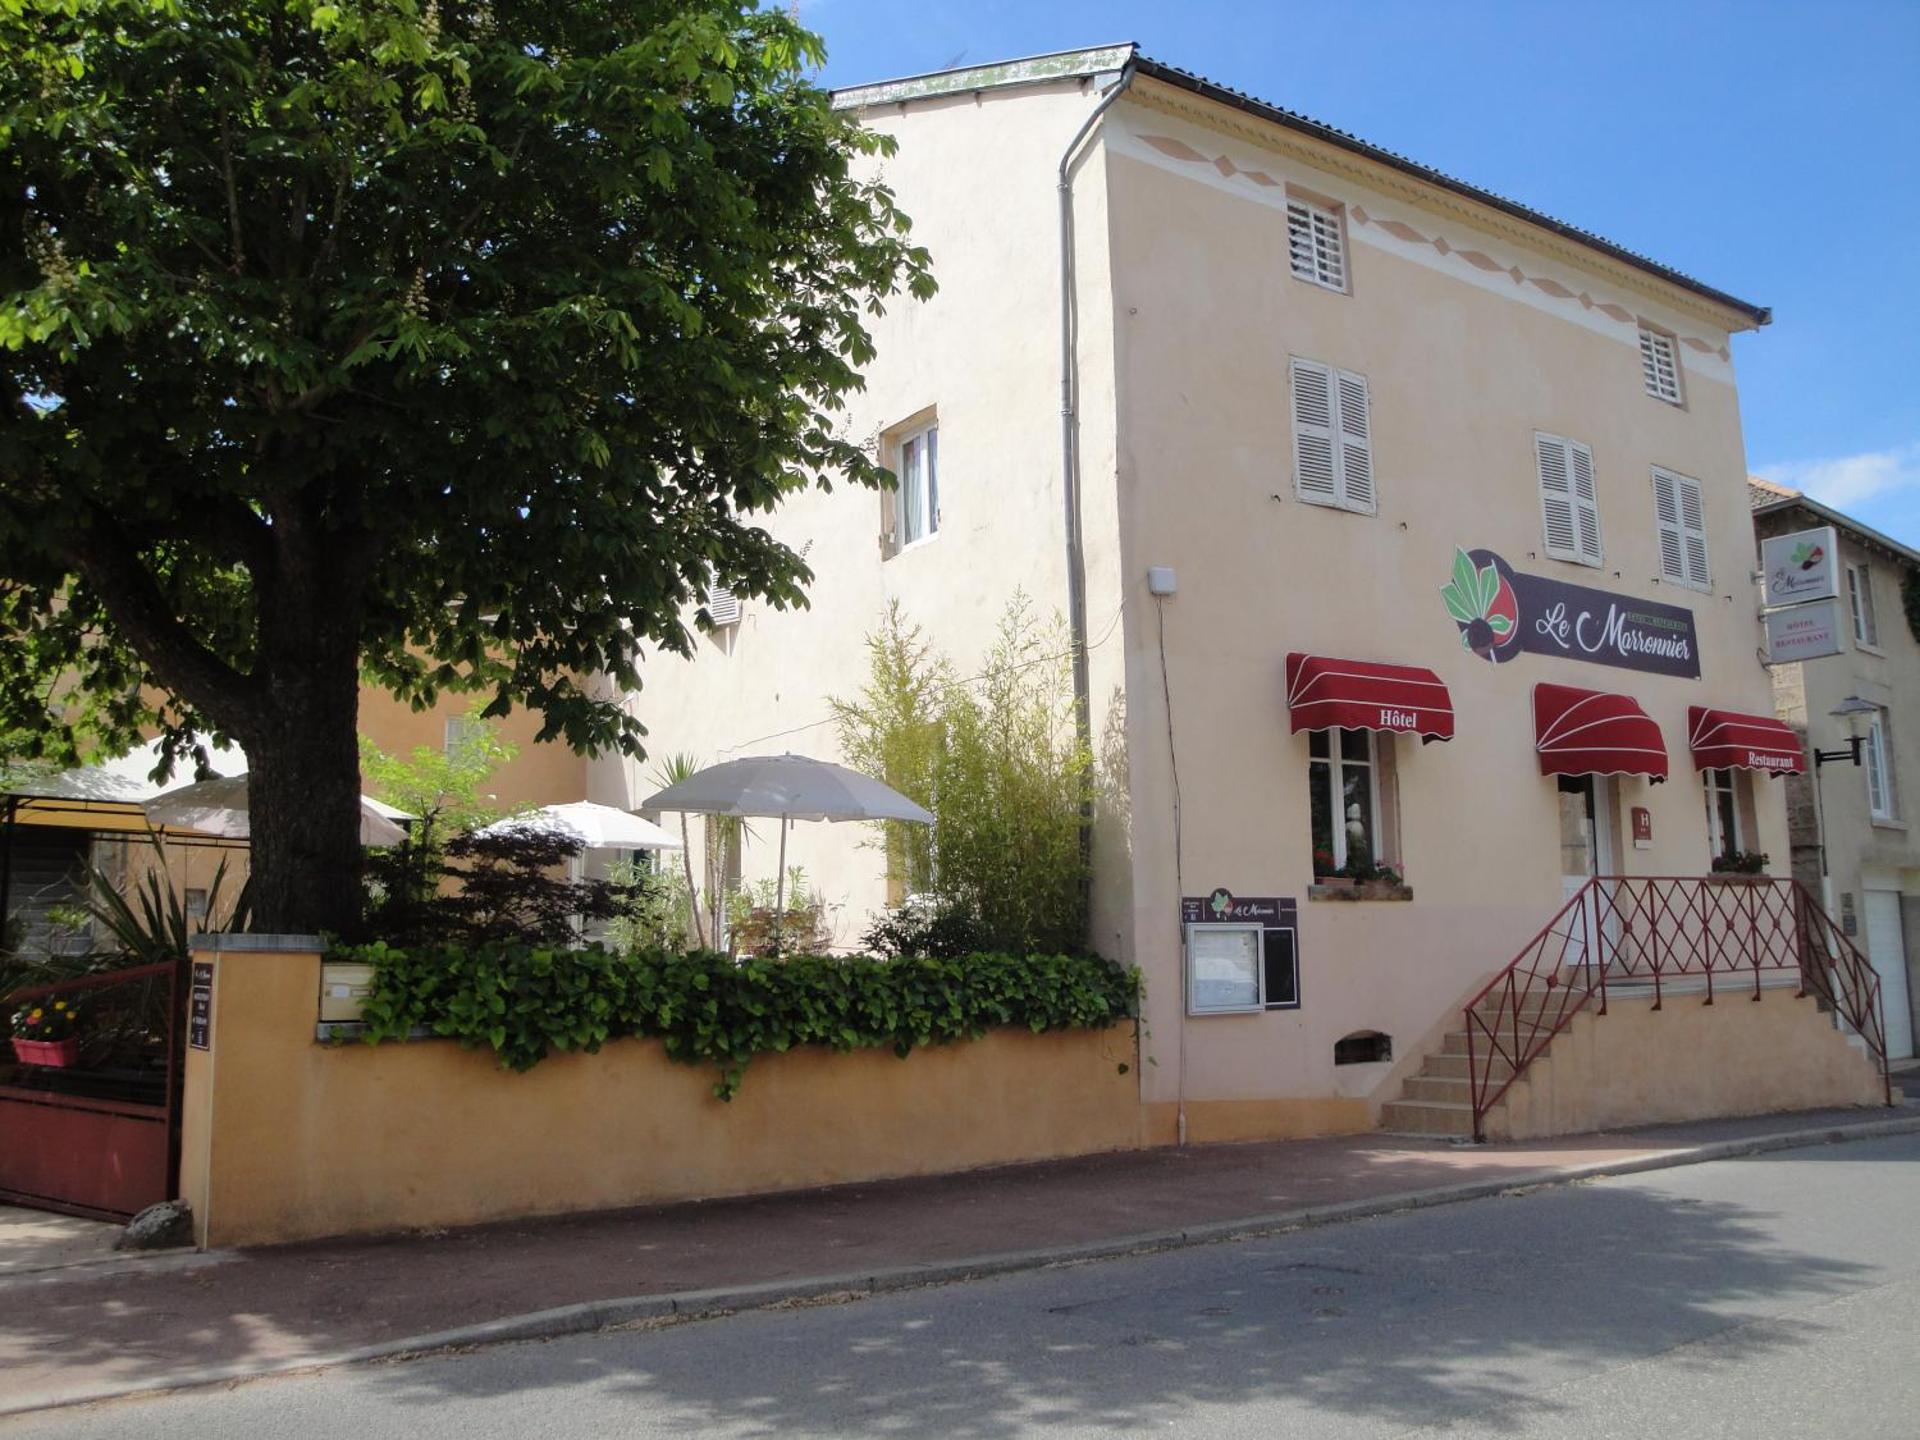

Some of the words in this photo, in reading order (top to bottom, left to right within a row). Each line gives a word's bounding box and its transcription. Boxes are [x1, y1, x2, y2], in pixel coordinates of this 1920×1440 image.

[1536, 602, 1570, 648] Le
[1577, 604, 1690, 659] Marronnier
[1380, 710, 1416, 728] Hôtel
[1748, 752, 1794, 767] Restaurant
[1641, 813, 1649, 826] H
